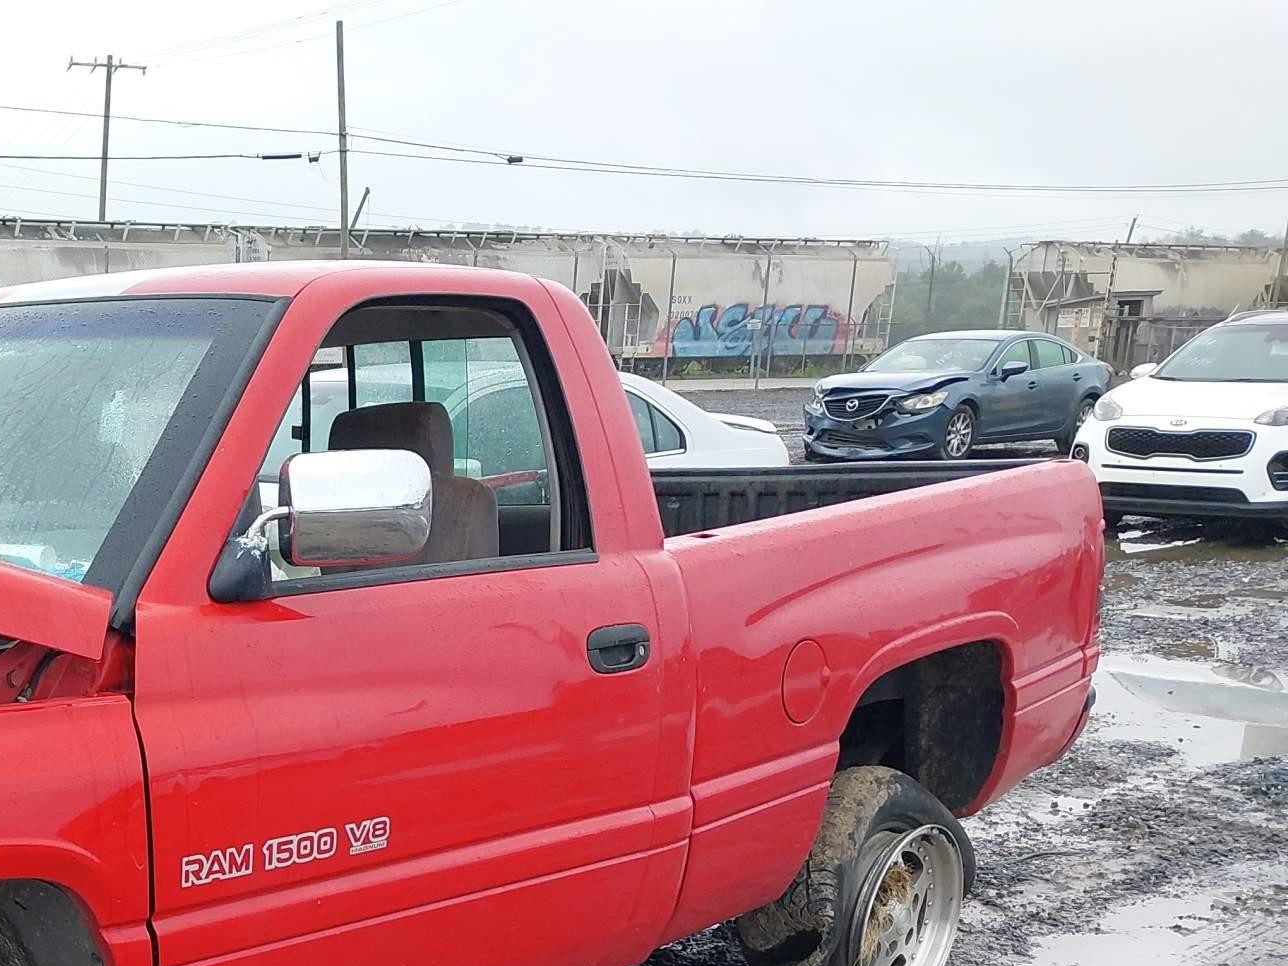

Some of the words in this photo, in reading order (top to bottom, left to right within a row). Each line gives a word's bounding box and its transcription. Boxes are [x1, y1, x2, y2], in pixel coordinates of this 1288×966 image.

[181, 844, 253, 888] RAM
[263, 828, 337, 870] 1500
[345, 816, 390, 847] V8
[350, 840, 387, 855] MAGNUM
